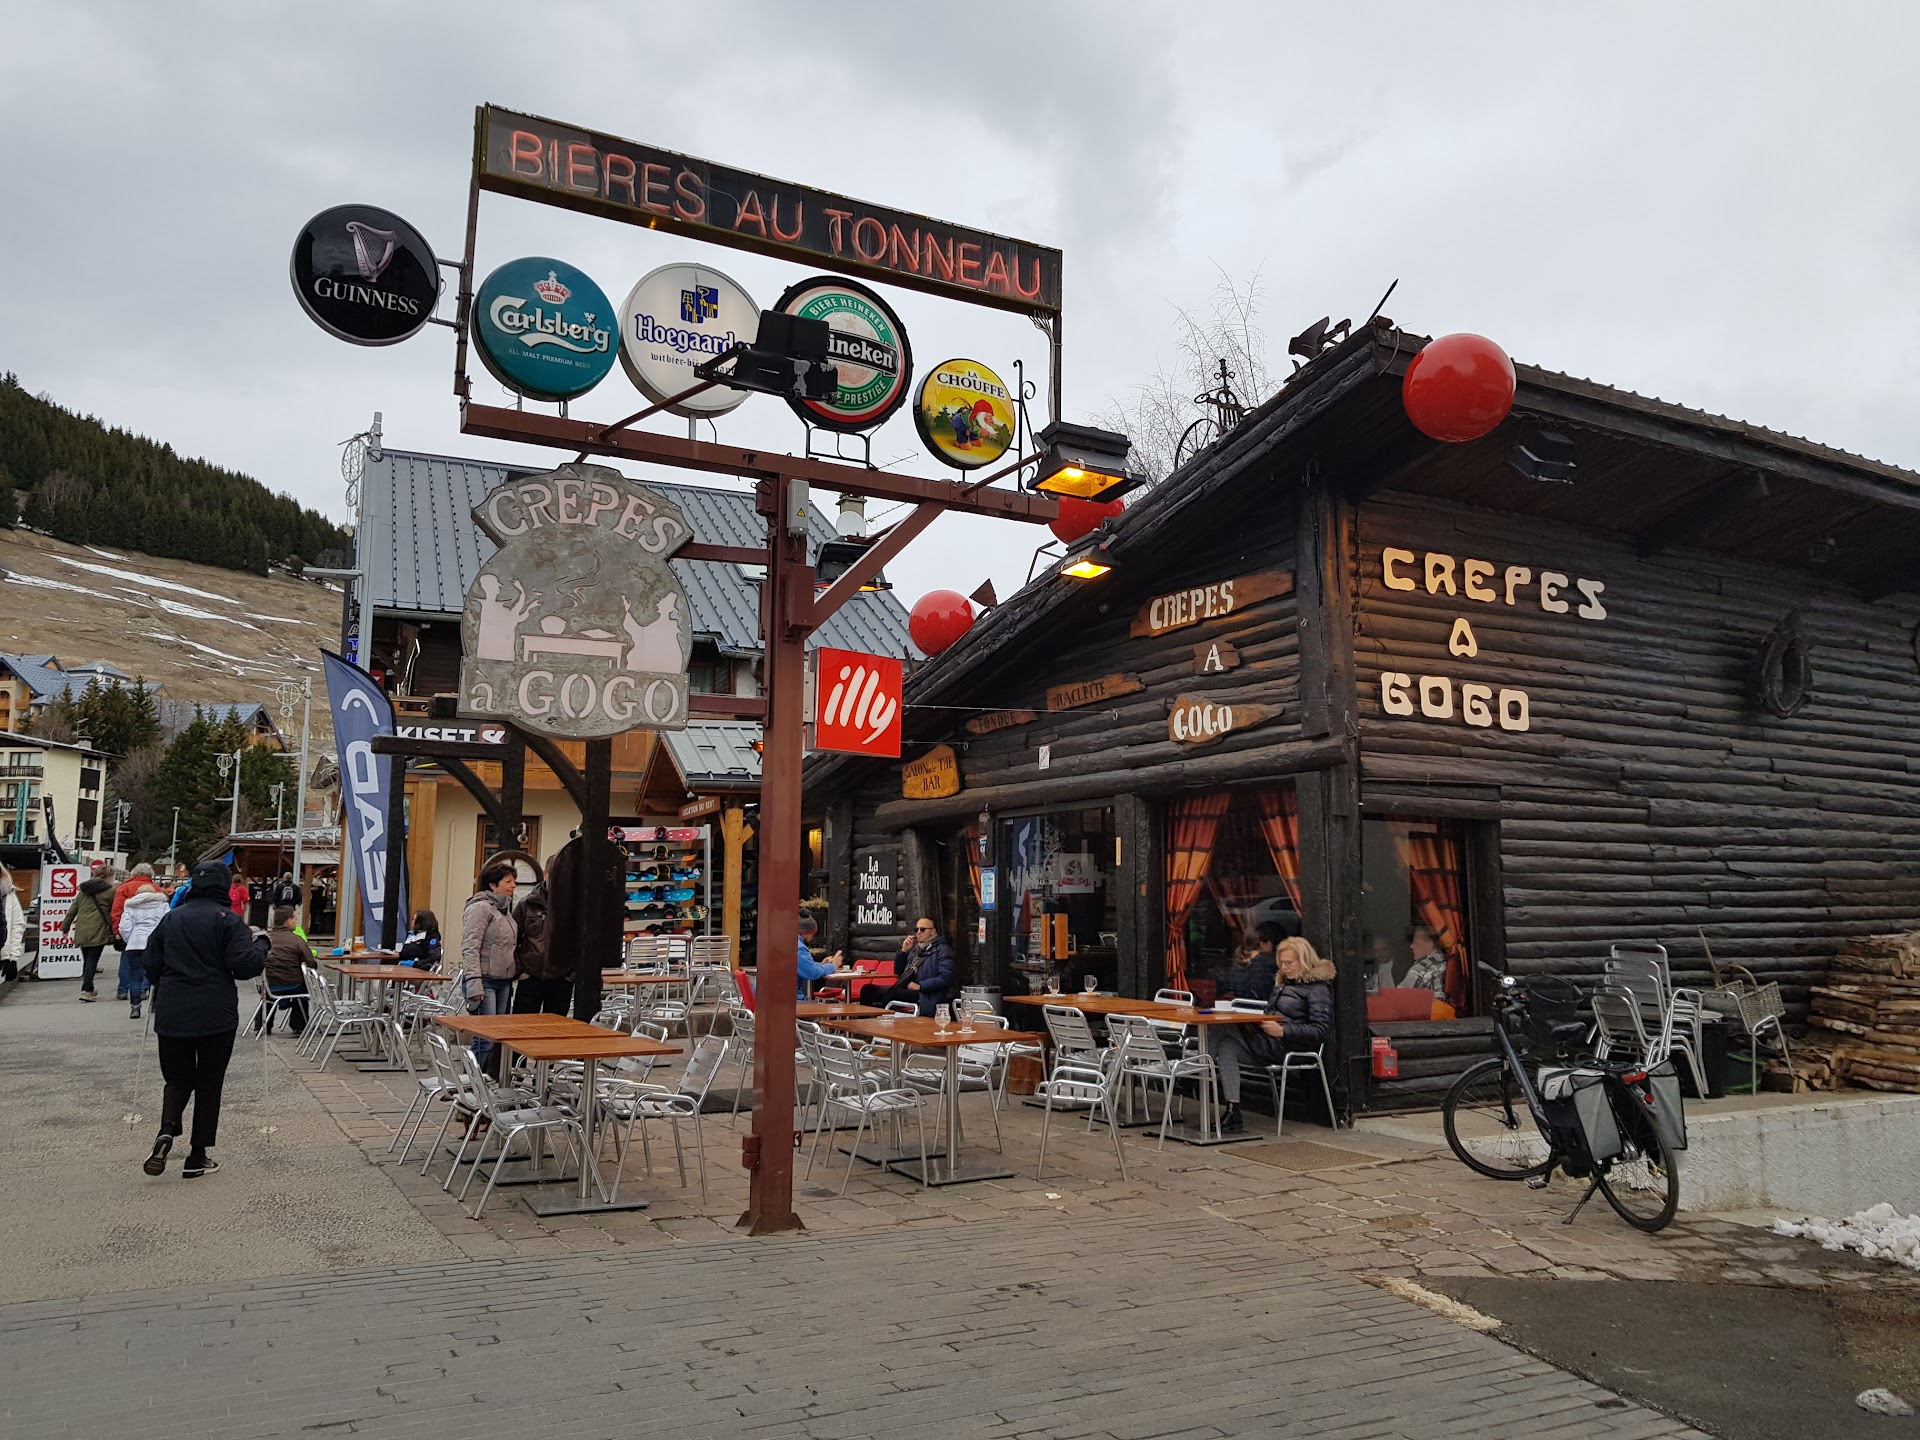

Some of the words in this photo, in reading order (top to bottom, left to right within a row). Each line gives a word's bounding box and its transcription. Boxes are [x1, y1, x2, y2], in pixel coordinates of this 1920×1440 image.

[509, 129, 706, 221] BIERES
[732, 189, 804, 242] AU
[822, 207, 1041, 298] TONNEAU
[313, 277, 420, 316] GUINNESS
[489, 294, 611, 353] Carlsberg
[808, 297, 838, 316] BIERE
[839, 297, 886, 332] HEINEKEN
[634, 313, 752, 354] Hoegaard
[507, 348, 520, 356] ALL
[522, 350, 540, 360] MALT
[542, 354, 573, 366] PREMIUM
[575, 360, 591, 369] BEER
[827, 333, 894, 369] ineken
[936, 372, 1005, 399] CHOUFFE
[967, 370, 978, 379] LA
[843, 380, 887, 404] PRESTIGE
[488, 466, 685, 554] CRÊPES
[1382, 546, 1608, 621] CREPES
[1149, 580, 1235, 630] CREPES
[1448, 617, 1478, 658] A
[1203, 642, 1223, 672] A
[470, 668, 496, 713] à
[518, 670, 680, 724] GOGO
[823, 664, 898, 746] illy
[1056, 681, 1106, 707] RACLETTE
[1380, 671, 1530, 732] GOGO
[978, 711, 1016, 731] FONDUE
[1172, 704, 1234, 741] GOGO
[904, 761, 928, 779] SALON
[937, 755, 953, 771] THE
[922, 775, 941, 792] BAR
[705, 799, 715, 809] RENT
[868, 855, 879, 872] La
[859, 872, 890, 890] Maison
[866, 890, 876, 904] de
[875, 890, 884, 904] la
[857, 904, 893, 925] Raclette
[41, 954, 82, 963] RENTAL
